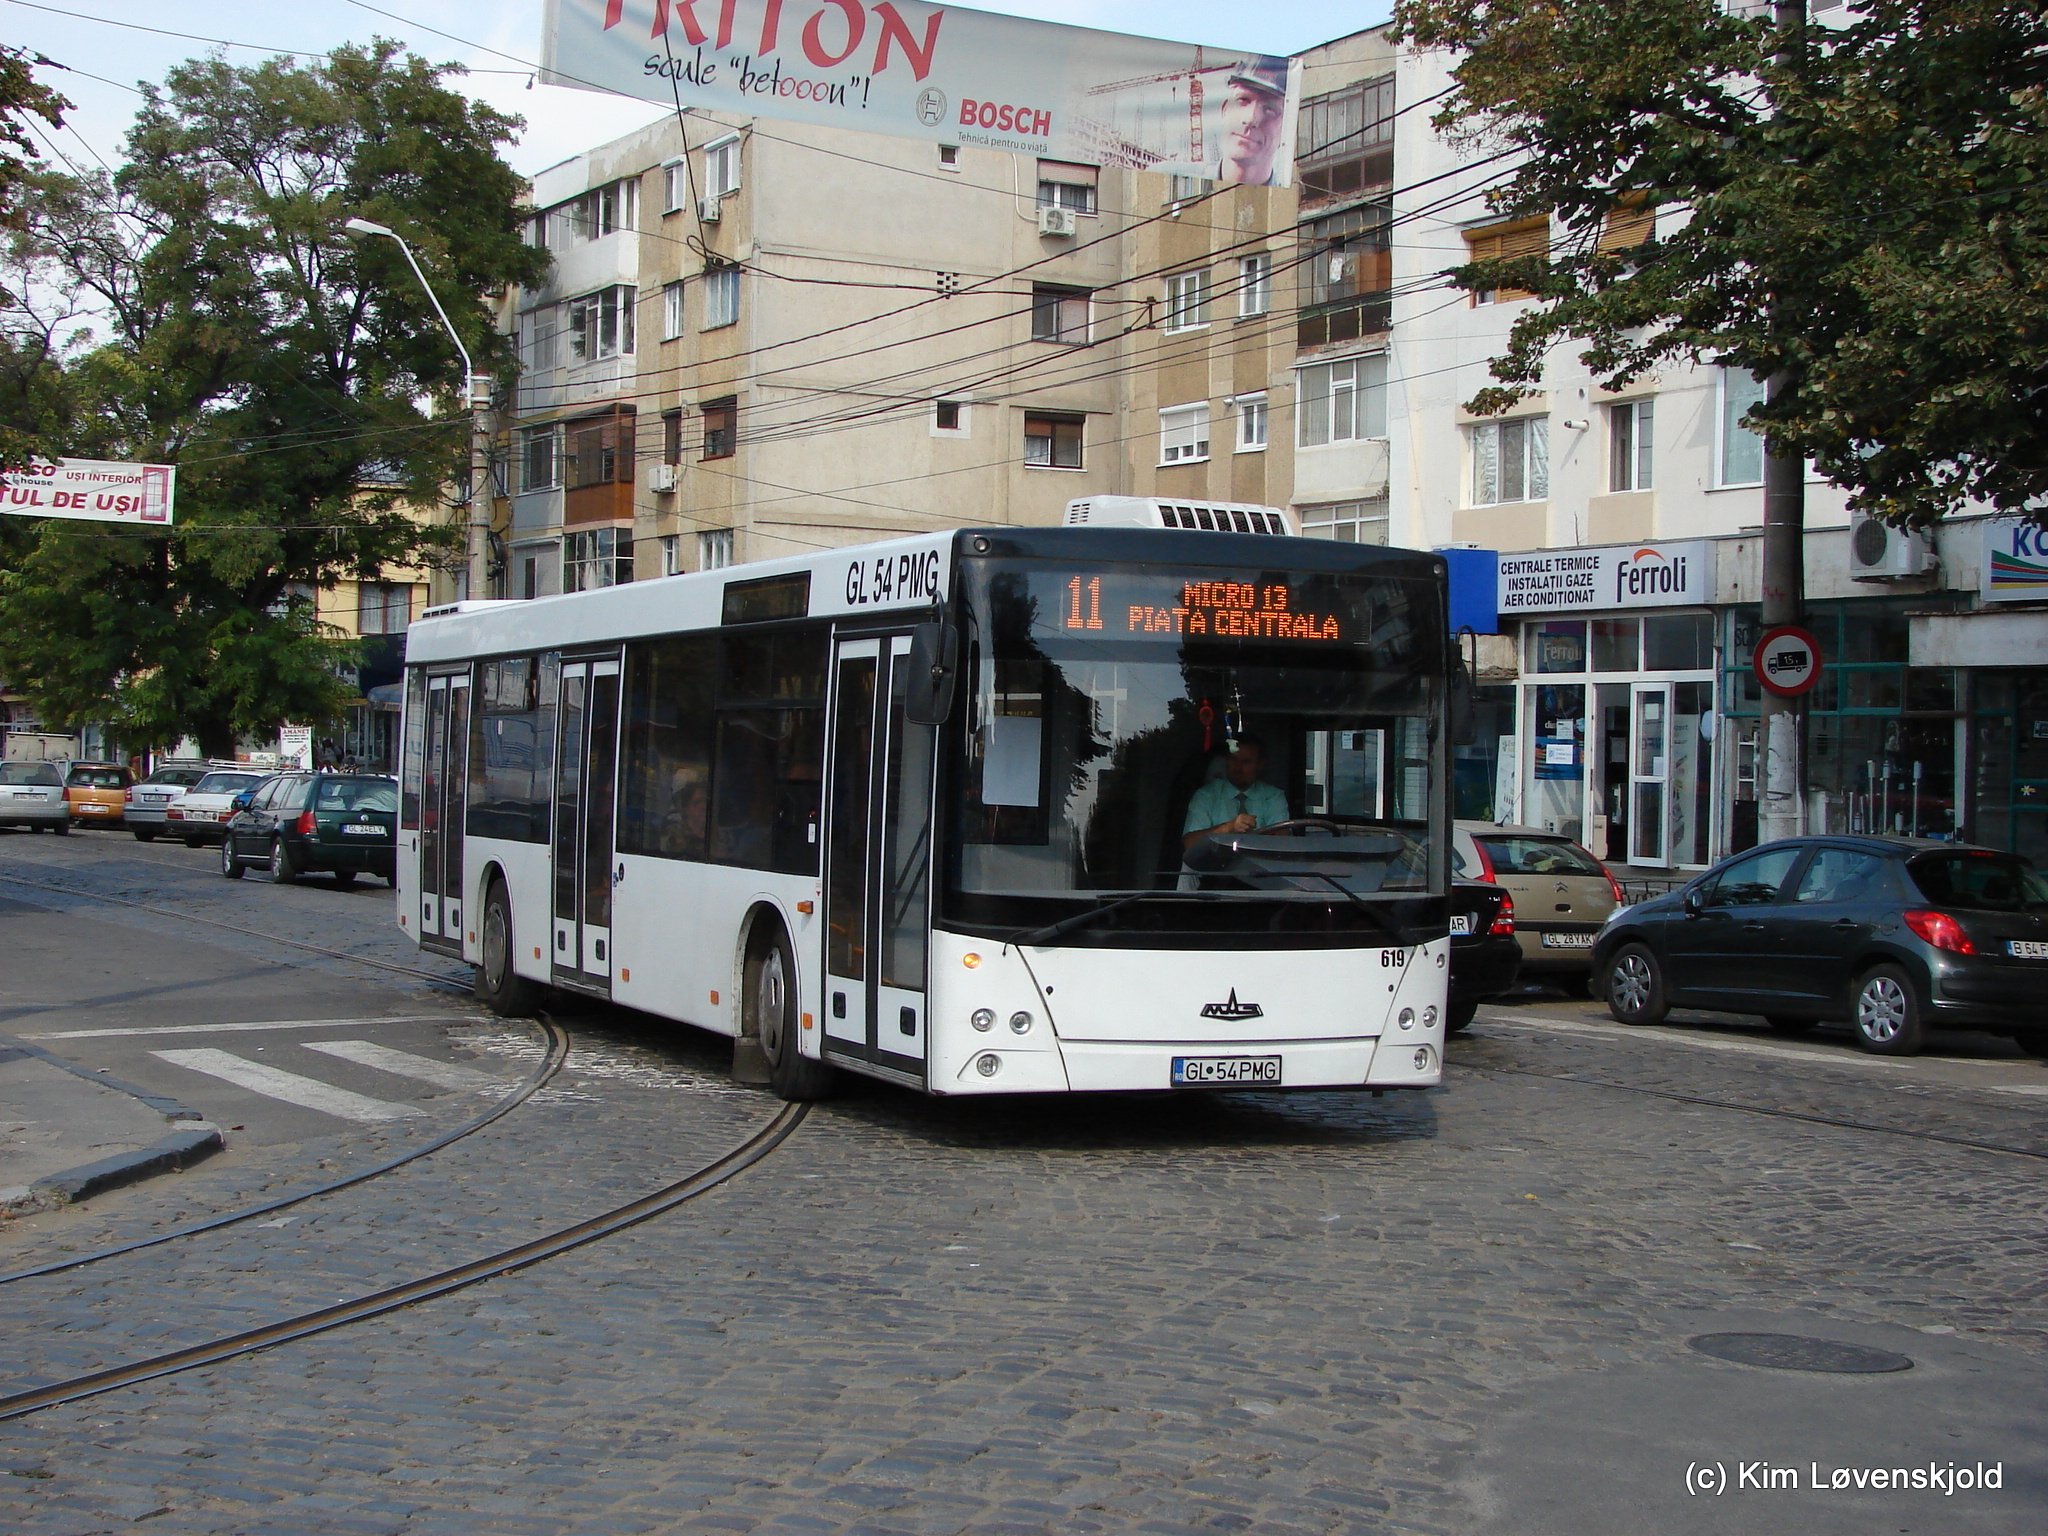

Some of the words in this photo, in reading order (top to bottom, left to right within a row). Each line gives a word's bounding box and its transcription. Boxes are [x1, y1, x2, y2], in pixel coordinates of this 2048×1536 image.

[643, 46, 718, 87] scule
[959, 98, 1051, 137] BOSCH
[957, 131, 989, 145] Tehnică
[990, 137, 1019, 149] pentru
[1020, 142, 1026, 150] o
[20, 477, 54, 486] house
[88, 472, 142, 485] INTERIOR
[52, 491, 88, 509] DE
[1500, 558, 1552, 576] CENTRALE
[1554, 555, 1600, 573] TERMICE
[846, 561, 867, 606] GL
[873, 557, 893, 603] 54
[897, 549, 939, 600] PMG
[1565, 573, 1593, 588] GAZE
[1616, 556, 1686, 603] Ferroli
[1067, 576, 1103, 629] 11
[1184, 581, 1254, 609] MICRO
[1262, 585, 1287, 610] 13
[1504, 593, 1524, 608] AER
[1129, 605, 1206, 634] PIATA
[1215, 609, 1339, 639] CENTRALA
[1451, 917, 1466, 931] AR
[1548, 933, 1560, 944] GL
[2013, 942, 2022, 954] B
[1381, 949, 1405, 968] 619
